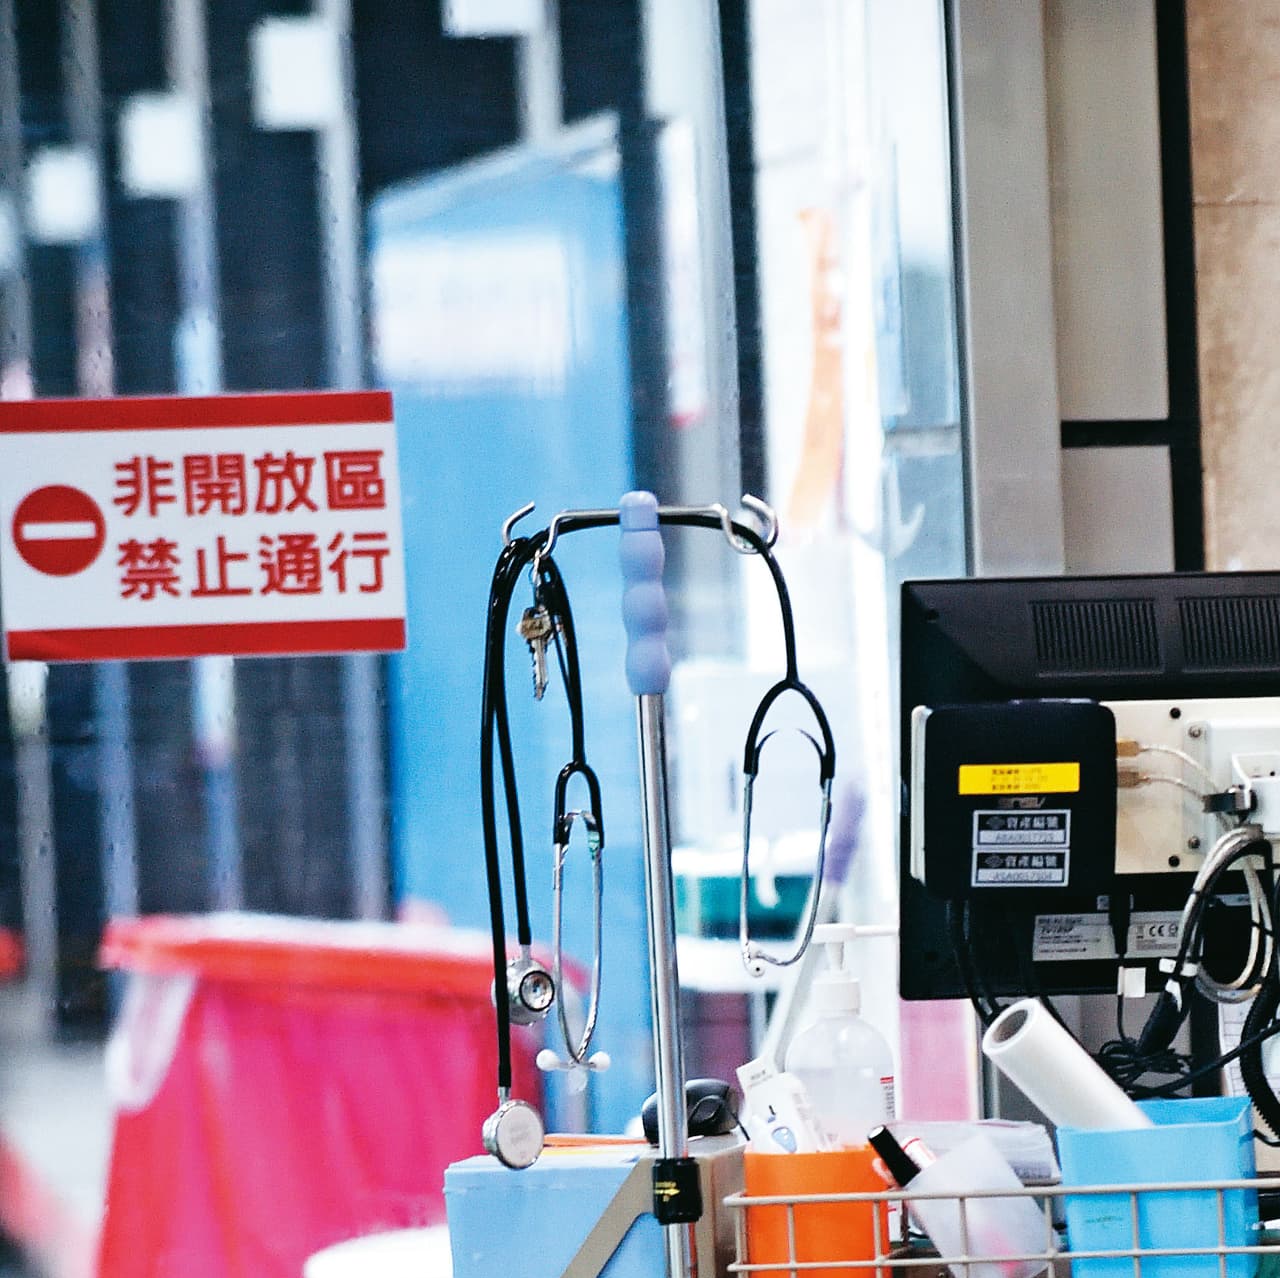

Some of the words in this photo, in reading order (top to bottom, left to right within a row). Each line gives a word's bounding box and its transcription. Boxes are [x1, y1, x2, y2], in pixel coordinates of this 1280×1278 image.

[113, 450, 386, 517] 非開放區
[117, 532, 390, 601] 禁止通行
